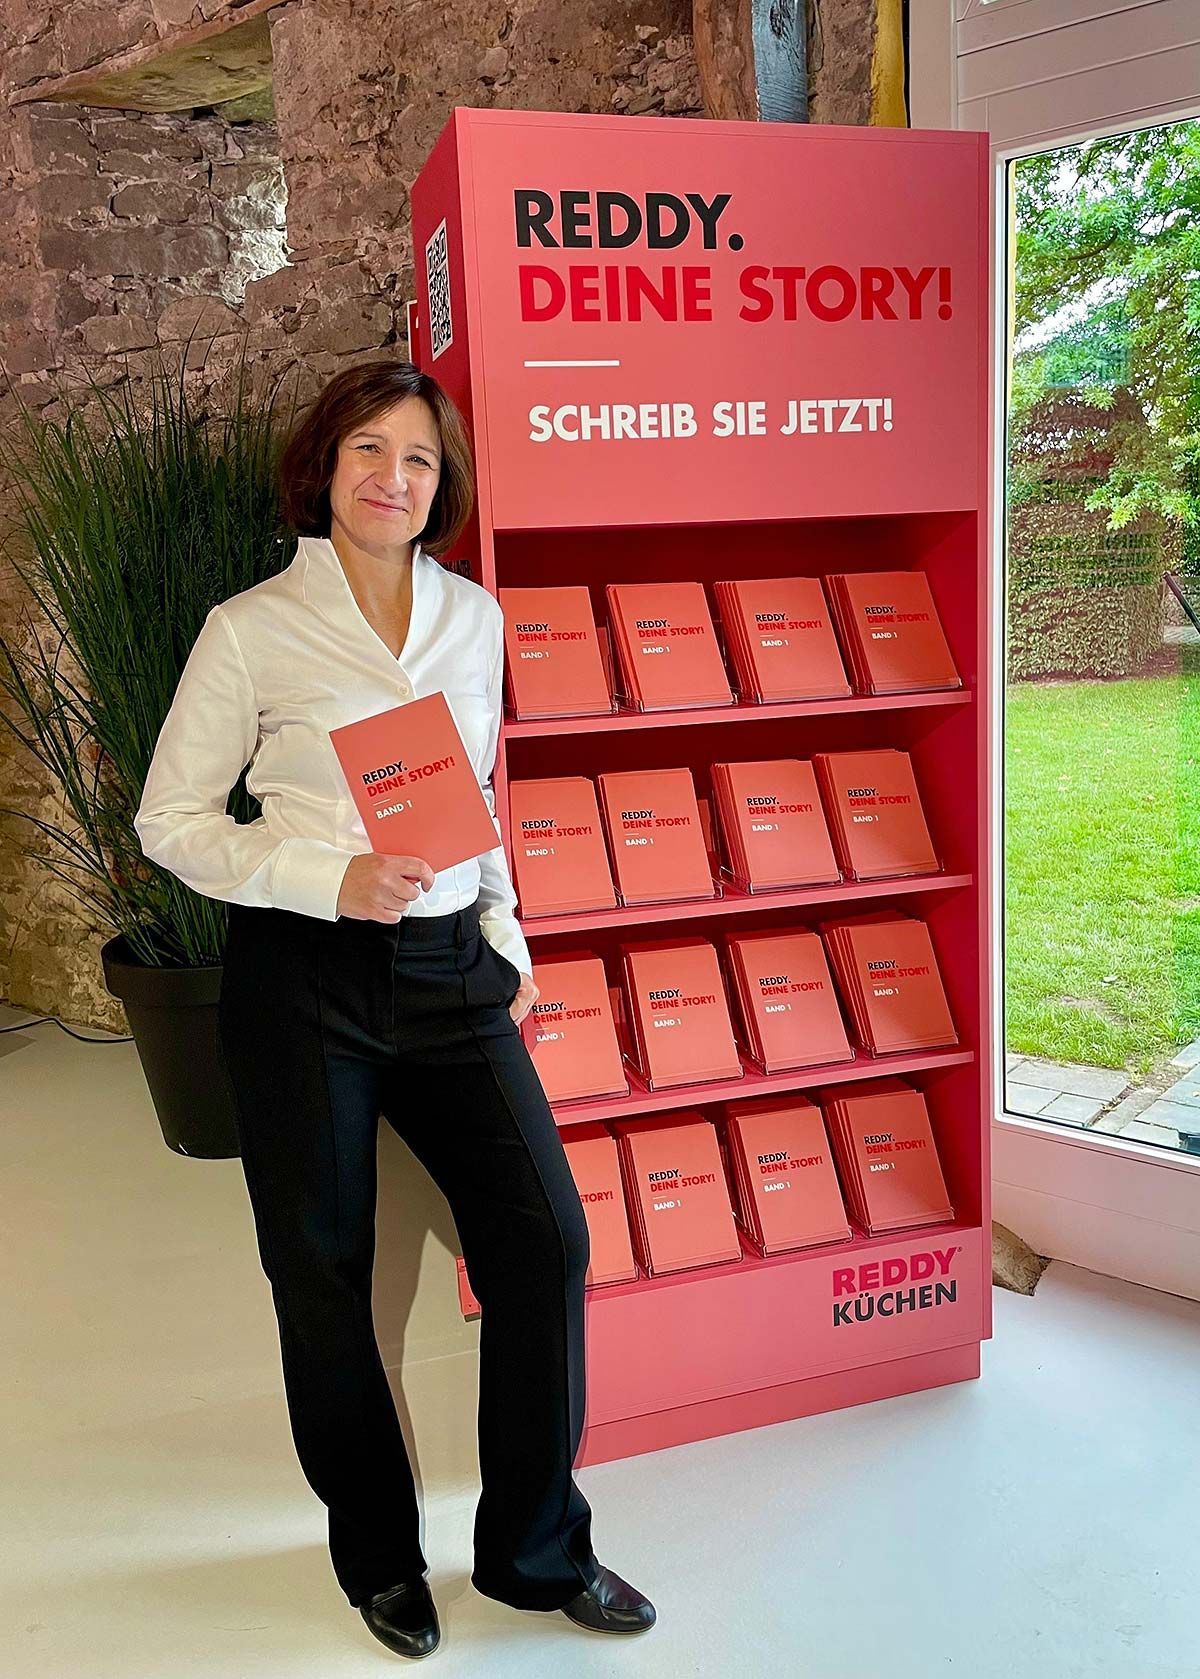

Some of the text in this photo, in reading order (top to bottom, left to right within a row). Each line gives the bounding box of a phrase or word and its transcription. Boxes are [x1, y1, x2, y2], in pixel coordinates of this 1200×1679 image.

[514, 188, 744, 251] REDDY.
[519, 265, 952, 322] DEINE STORY!
[528, 398, 894, 442] SCHREIB SIE JETZT!
[865, 606, 896, 614] REDDY.
[755, 614, 788, 622] REDDY.
[867, 613, 929, 623] DEINE STORY!
[516, 624, 551, 632] REDDY.
[636, 620, 670, 629] REDDY.
[758, 620, 822, 630] DEINE STORY!
[518, 632, 586, 642] DEINE STORY!
[638, 626, 704, 638] DEINE STORY!
[642, 646, 664, 654] BAND
[362, 761, 407, 784] REDDY.
[367, 756, 455, 797] DEINE STORY!
[848, 788, 879, 797] REDDY.
[747, 797, 780, 806] REDDY.
[850, 796, 911, 807] DEINE STORY!
[376, 800, 413, 819] BAND 1
[749, 804, 812, 815] DEINE STORY!
[621, 810, 656, 820] REDDY.
[522, 820, 557, 829] REDDY.
[623, 817, 690, 829] DEINE STORY!
[523, 826, 592, 839] DEINE STORY!
[625, 838, 648, 846] BAND
[526, 849, 548, 857] BAND
[868, 960, 899, 970] REDDY.
[870, 967, 930, 979] DEINE STORY!
[759, 976, 792, 986] REDDY.
[761, 982, 823, 996] DEINE STORY!
[873, 989, 894, 997] BAND
[649, 989, 682, 1000] REDDY.
[532, 1002, 566, 1013] REDDY.
[651, 995, 716, 1010] DEINE STORY!
[765, 1005, 786, 1013] BAND
[533, 1008, 601, 1024] DEINE STORY!
[654, 1019, 675, 1028] BAND
[536, 1033, 558, 1042] BAND
[864, 1134, 895, 1144] REDDY.
[866, 1140, 926, 1154] DEINE STORY!
[758, 1152, 790, 1164] REDDY.
[760, 1156, 823, 1174] DEINE STORY!
[870, 1164, 890, 1172] BAND
[648, 1169, 682, 1182] REDDY.
[650, 1174, 716, 1192] DEINE STORY!
[764, 1183, 785, 1192] BAND
[654, 1201, 675, 1211] BAND
[833, 1280, 957, 1327] KÜCHEN
